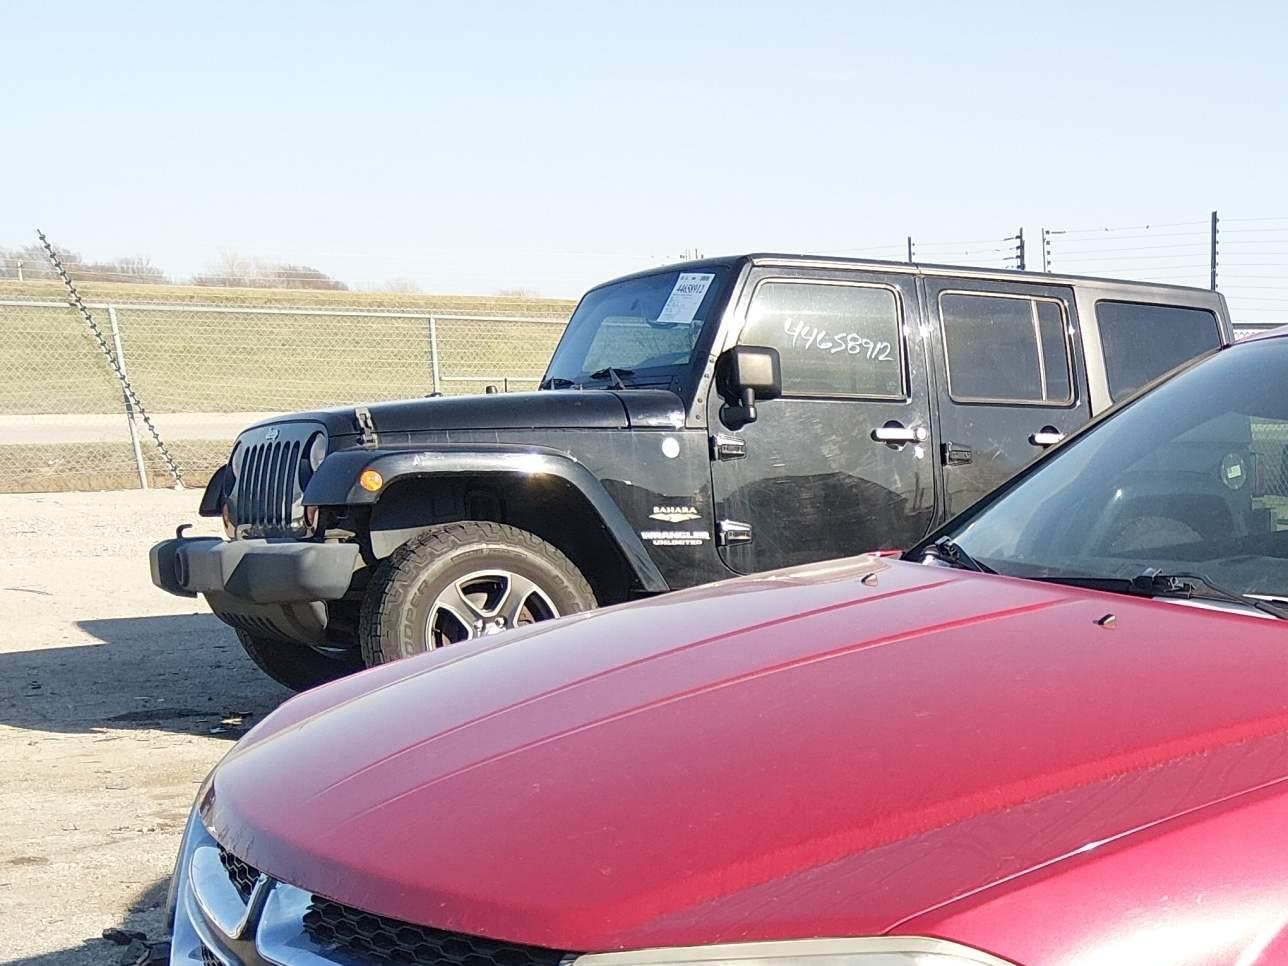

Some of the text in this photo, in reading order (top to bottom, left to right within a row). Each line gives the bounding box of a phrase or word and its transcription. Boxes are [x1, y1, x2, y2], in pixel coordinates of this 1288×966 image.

[784, 319, 895, 361] 44658912
[640, 531, 711, 540] WRANGLER
[404, 579, 428, 654] OOPER
